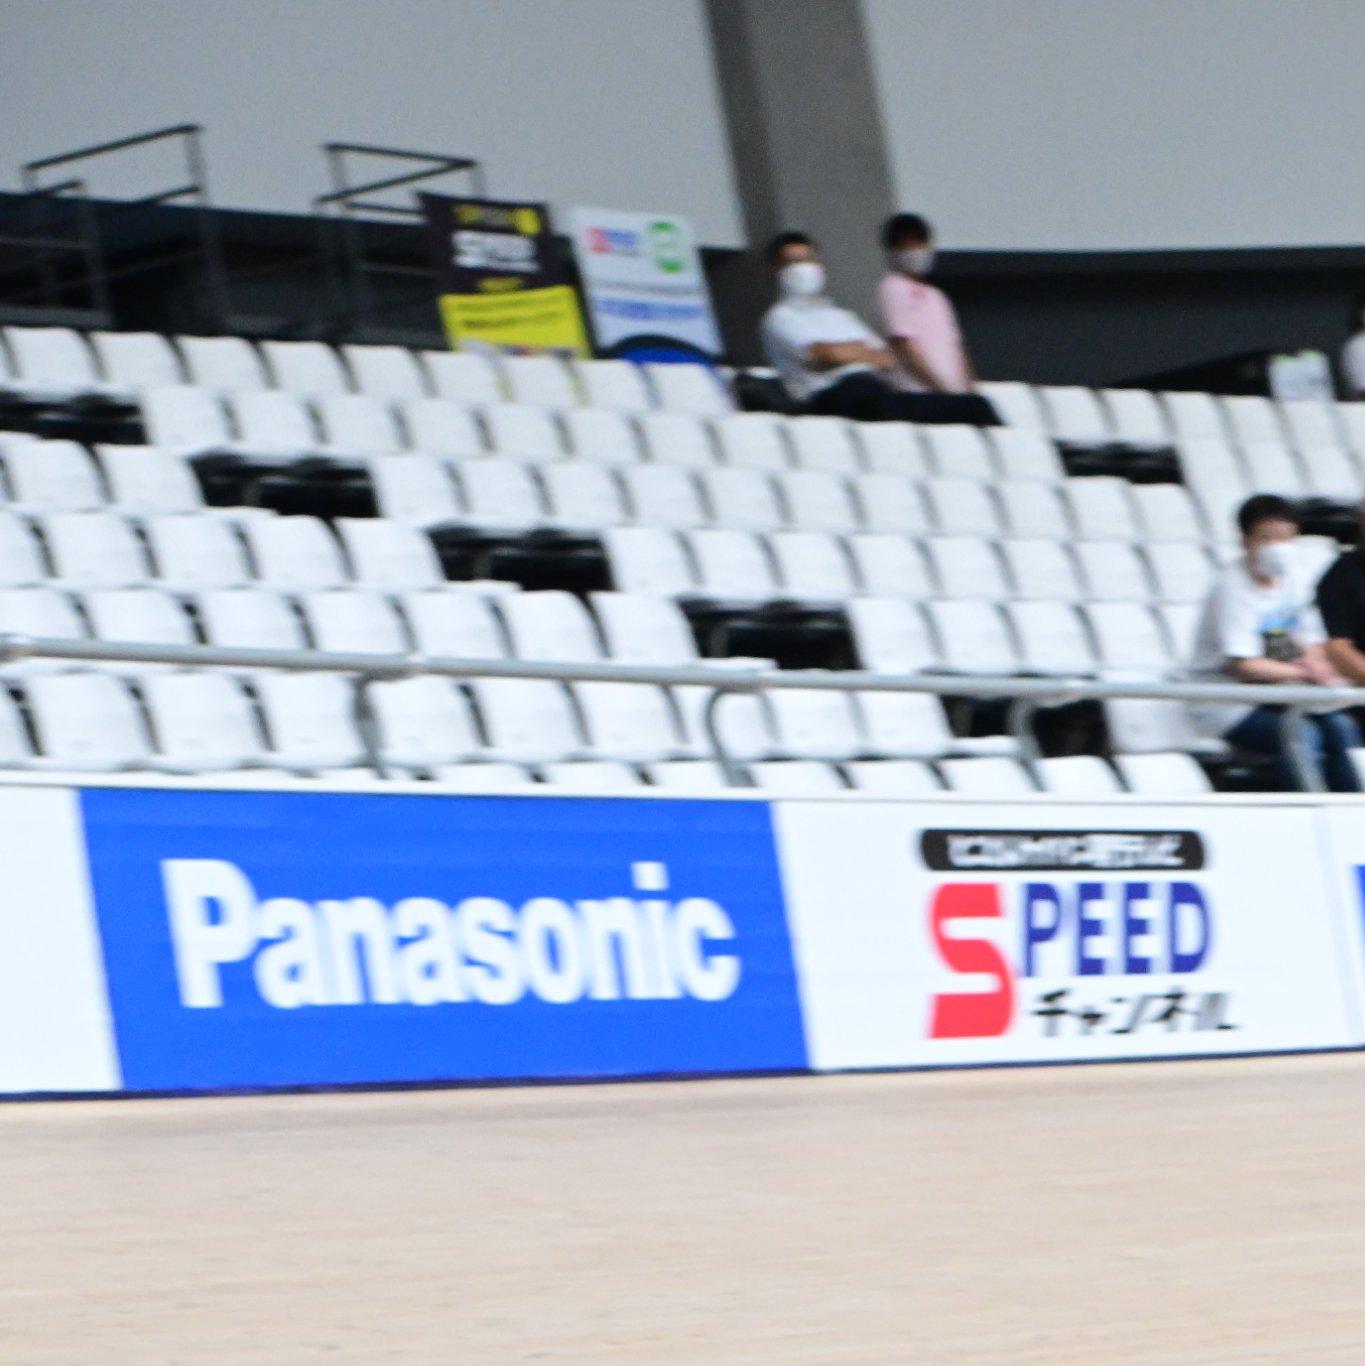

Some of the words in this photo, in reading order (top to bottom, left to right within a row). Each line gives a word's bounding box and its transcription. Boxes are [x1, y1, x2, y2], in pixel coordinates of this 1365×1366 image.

[159, 857, 743, 1009] Panasonic
[928, 881, 1214, 1040] SPEED
[1032, 985, 1240, 1038] チャンネル
